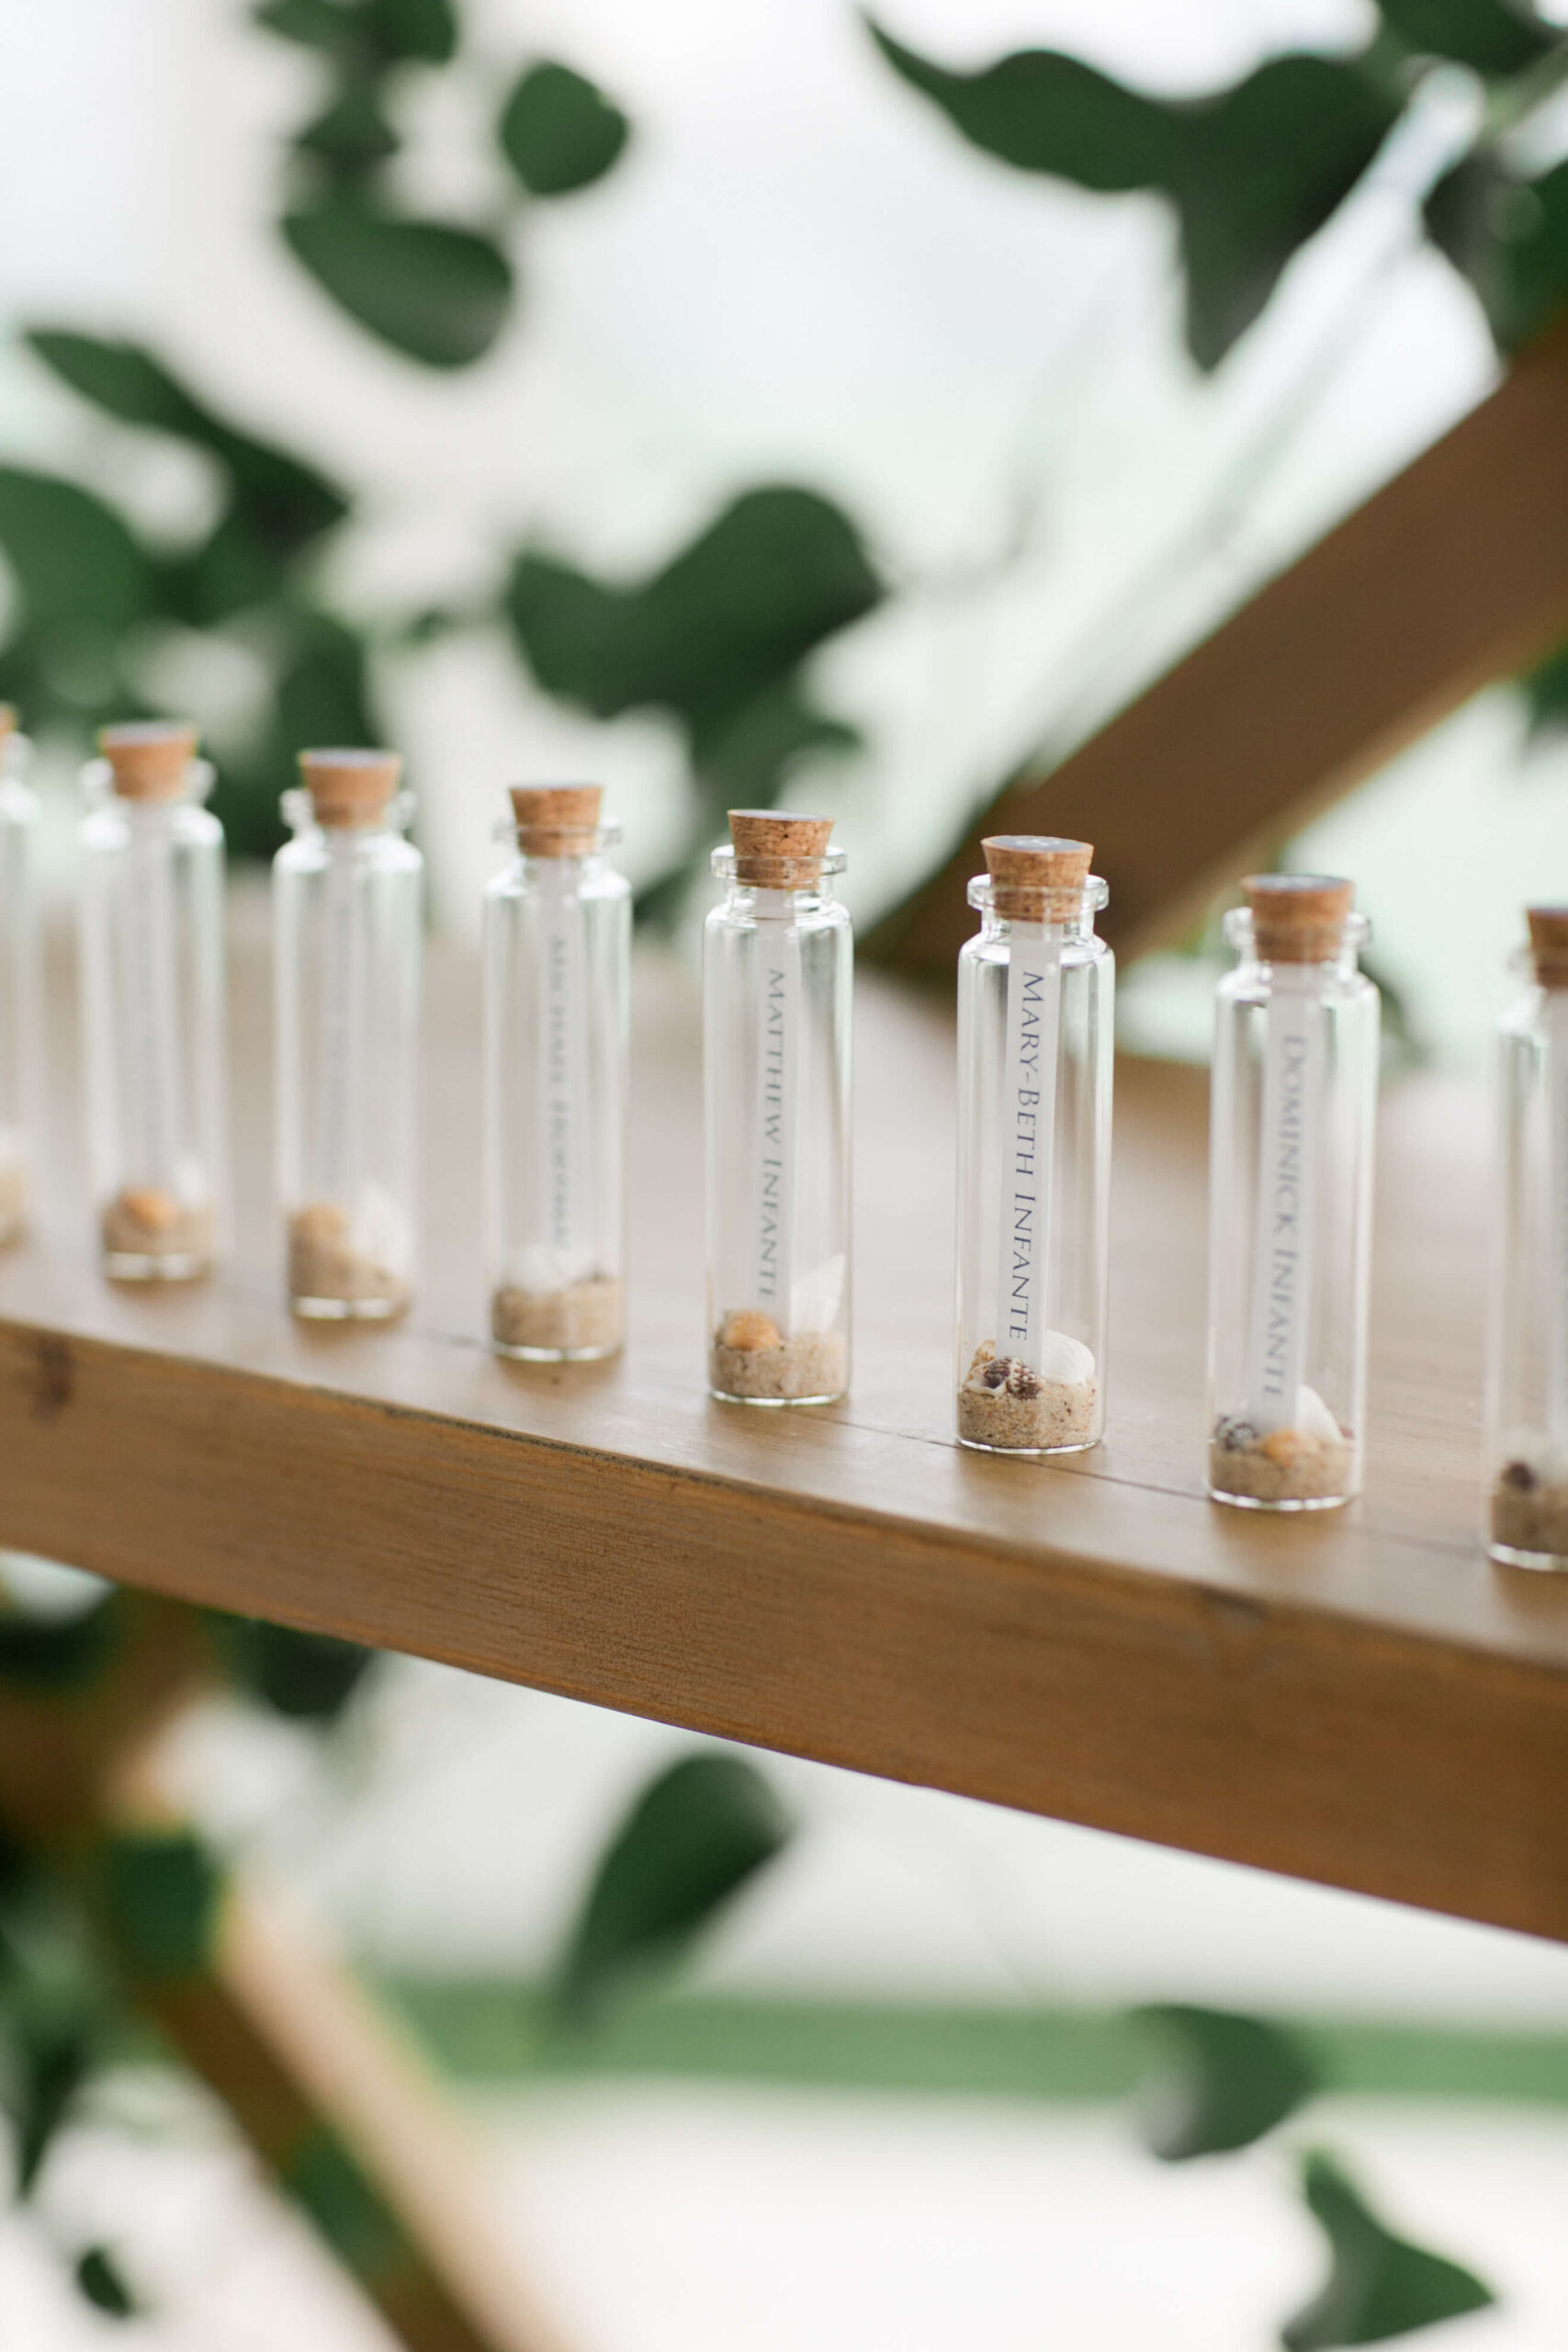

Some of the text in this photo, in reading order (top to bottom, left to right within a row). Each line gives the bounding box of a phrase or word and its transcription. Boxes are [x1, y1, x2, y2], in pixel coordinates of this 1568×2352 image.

[759, 968, 784, 1302] MATTHEW INFANTE
[1010, 971, 1044, 1340] MARY-BETH INFANTE
[1263, 1035, 1307, 1397] DOMINICK INFANTE
